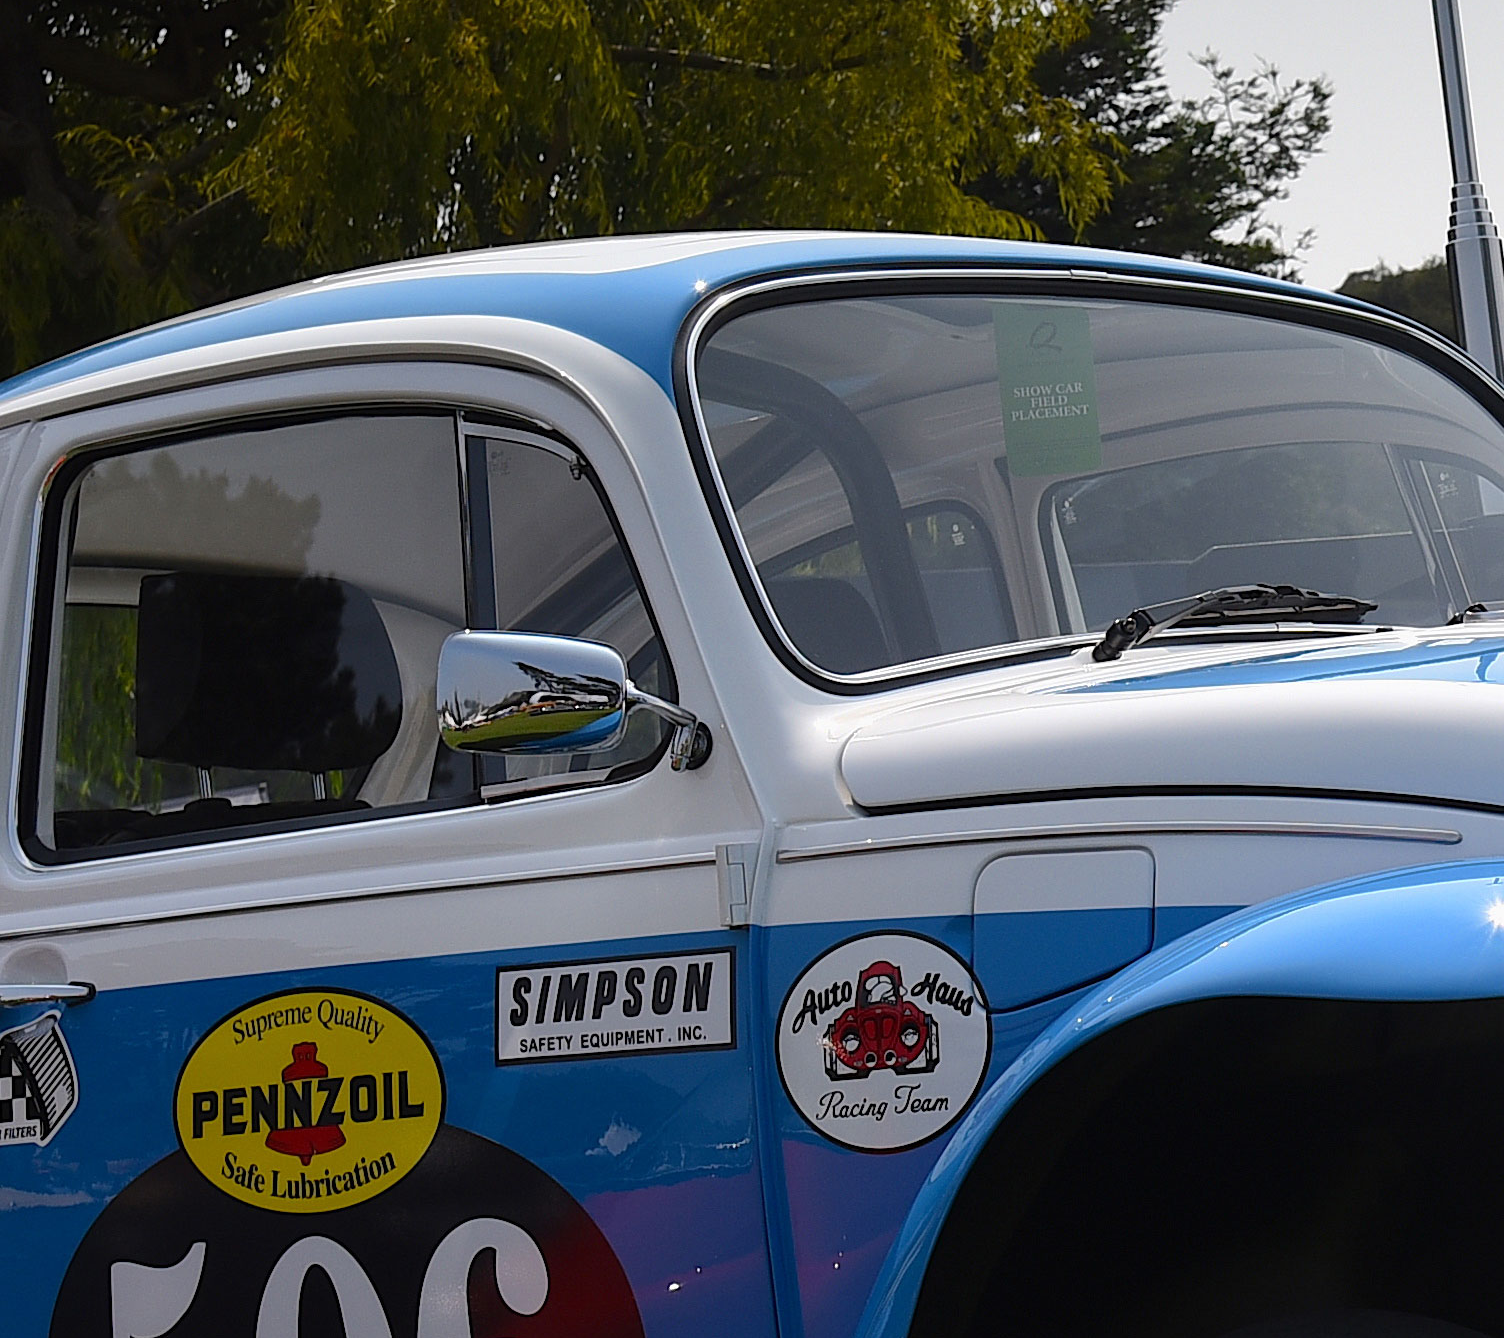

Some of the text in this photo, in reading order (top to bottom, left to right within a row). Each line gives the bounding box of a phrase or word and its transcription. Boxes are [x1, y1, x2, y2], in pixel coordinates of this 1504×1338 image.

[1013, 381, 1084, 398] SHOW CAR
[1030, 395, 1068, 409] FIELD
[1011, 404, 1090, 422] PLACEMENT
[509, 961, 714, 1027] SIMPSON
[791, 972, 974, 1034] Auto Haus
[231, 998, 385, 1045] Supreme Quality
[519, 1035, 574, 1053] SAFETY
[677, 1025, 707, 1041] INC.
[191, 1069, 425, 1139] PENNZOIL
[815, 1082, 949, 1121] Racing Team
[3, 1125, 38, 1140] FILTERS
[220, 1150, 397, 1200] Safe Lubrication
